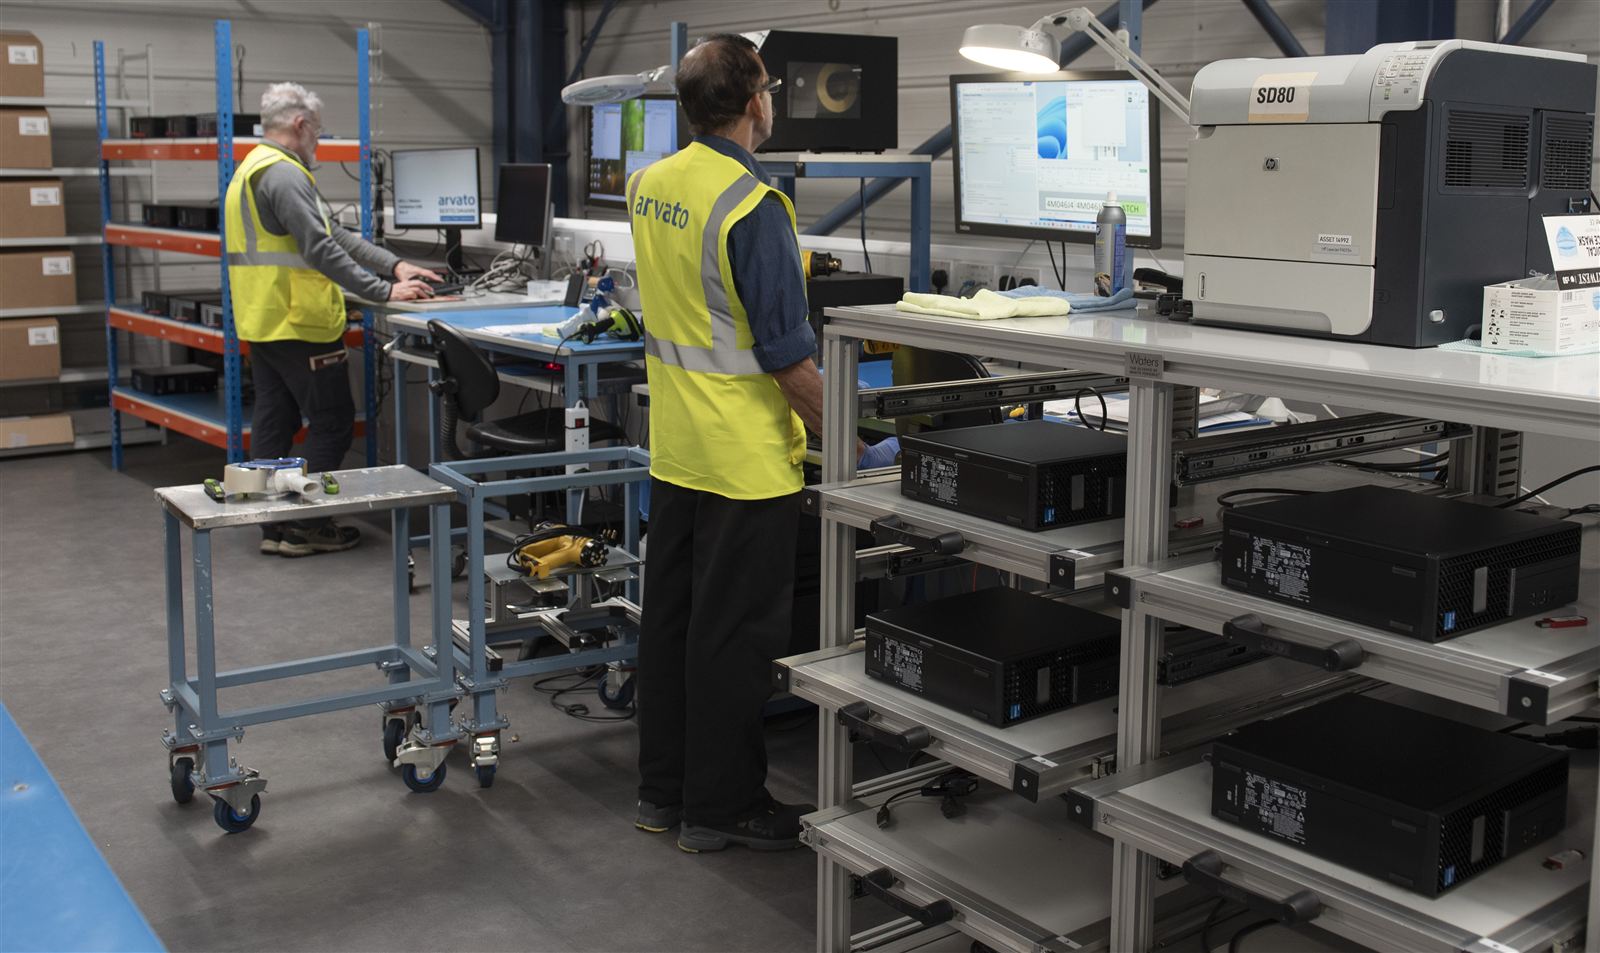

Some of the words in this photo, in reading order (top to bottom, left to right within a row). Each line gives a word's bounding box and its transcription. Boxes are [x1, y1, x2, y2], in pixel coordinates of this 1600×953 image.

[1256, 86, 1296, 104] SD80
[438, 194, 476, 206] arvato
[635, 195, 689, 230] arvato
[1129, 353, 1159, 368] Waters
